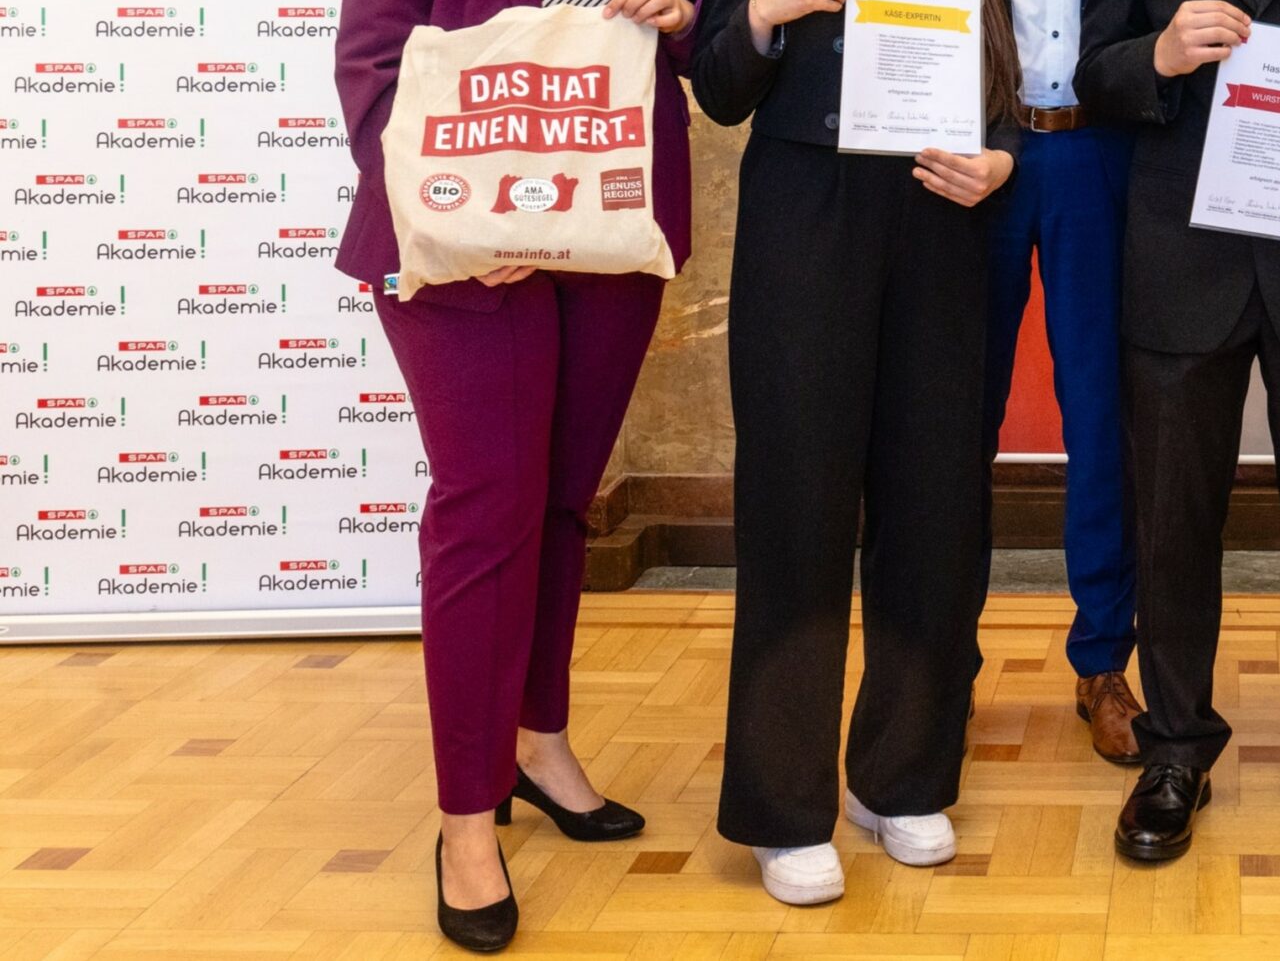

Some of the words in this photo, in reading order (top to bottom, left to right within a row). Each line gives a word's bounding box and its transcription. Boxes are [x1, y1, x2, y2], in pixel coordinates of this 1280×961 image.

[470, 69, 529, 103] DAS
[541, 72, 600, 102] HAT
[434, 115, 528, 150] EINEN
[540, 115, 636, 145] WERT.
[603, 180, 642, 191] GENUSS
[433, 186, 459, 196] BIO
[524, 186, 543, 194] AMA
[603, 189, 643, 199] REGION
[493, 248, 571, 260] amainfo.at
[45, 288, 84, 296] SPAR
[127, 343, 165, 351] SPAR
[46, 400, 84, 408] SPAR
[127, 454, 165, 462] SPAR
[288, 451, 327, 459] SPAR
[46, 512, 85, 520] SPAR
[128, 566, 166, 574] SPAR
[288, 562, 327, 570] SPAR
